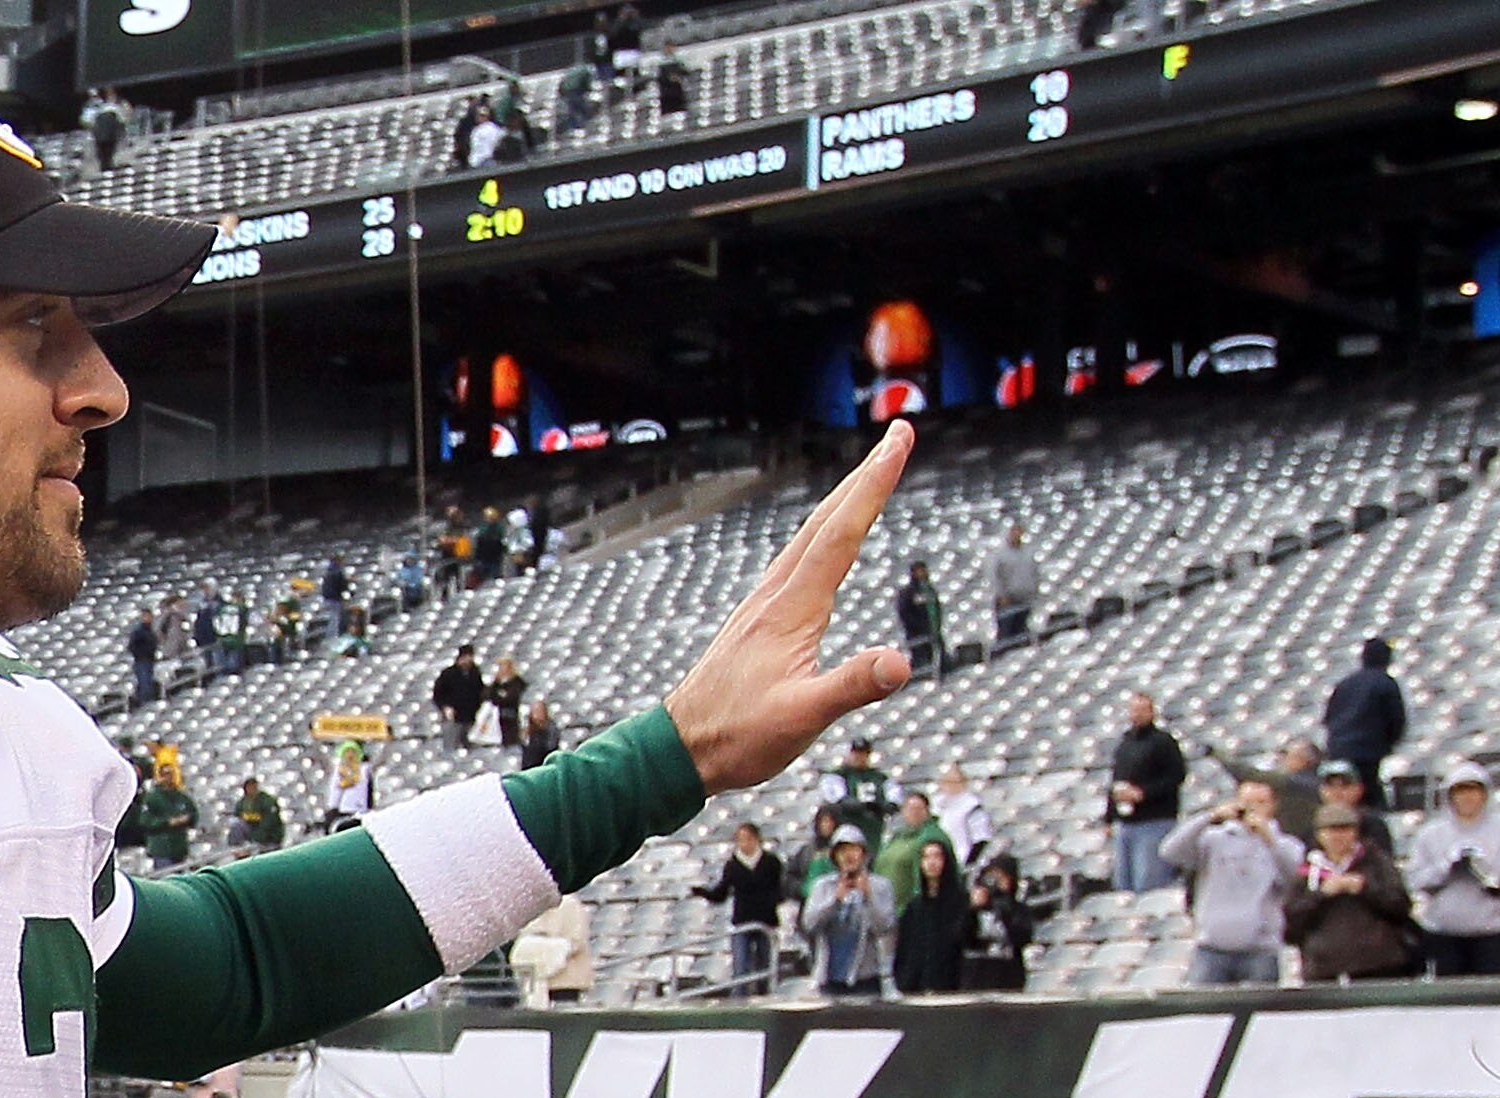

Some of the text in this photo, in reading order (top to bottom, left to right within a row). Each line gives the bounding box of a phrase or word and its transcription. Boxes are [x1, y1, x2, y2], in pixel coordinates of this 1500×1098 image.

[1163, 43, 1192, 80] F
[820, 69, 1071, 148] PANTHERS 10
[820, 105, 1070, 183] RAMS 20
[478, 178, 500, 207] 4
[543, 180, 588, 209] 1ST
[586, 172, 637, 203] AND
[666, 161, 704, 190] ON
[211, 196, 396, 252] SKINS 25
[465, 206, 525, 242] 2:10
